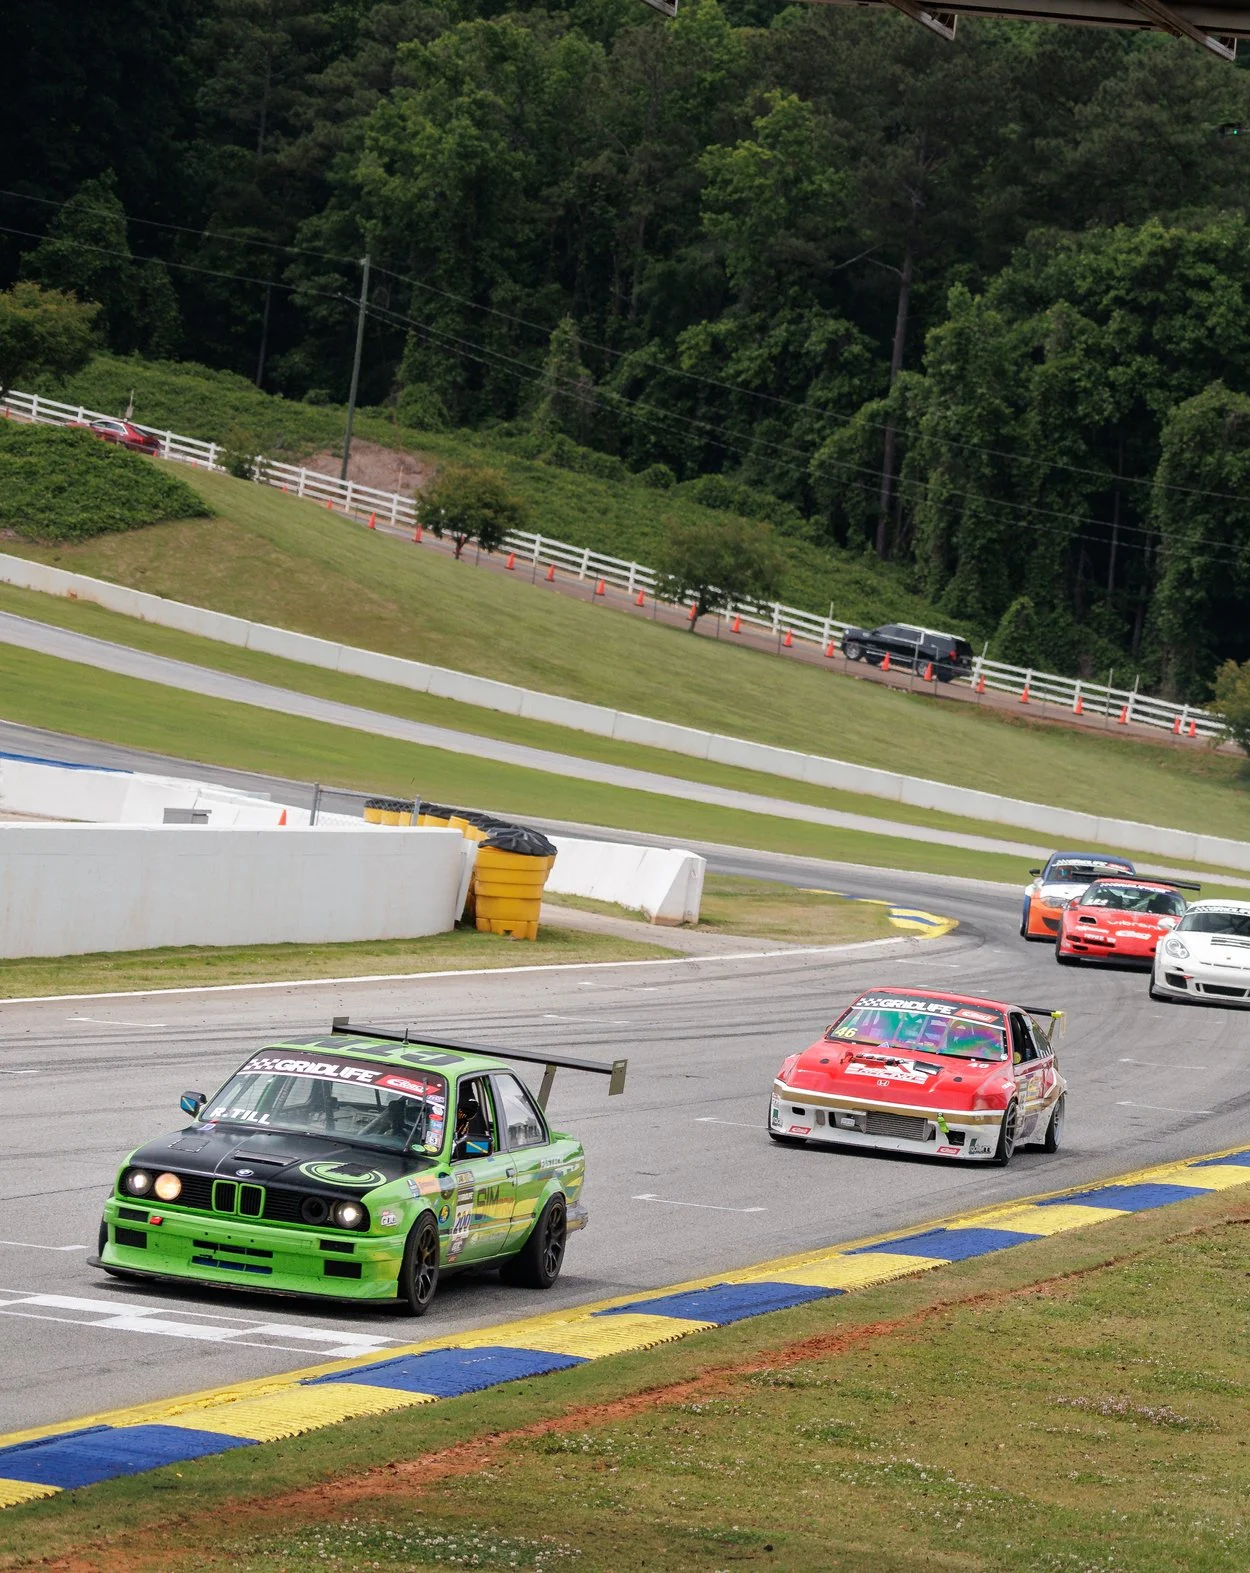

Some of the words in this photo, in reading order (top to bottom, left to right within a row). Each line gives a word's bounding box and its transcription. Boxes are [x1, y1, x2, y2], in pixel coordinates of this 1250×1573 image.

[879, 999, 957, 1015] GRIDLIFE
[835, 1026, 857, 1038] 46
[275, 1059, 384, 1083] GRIDLIFE
